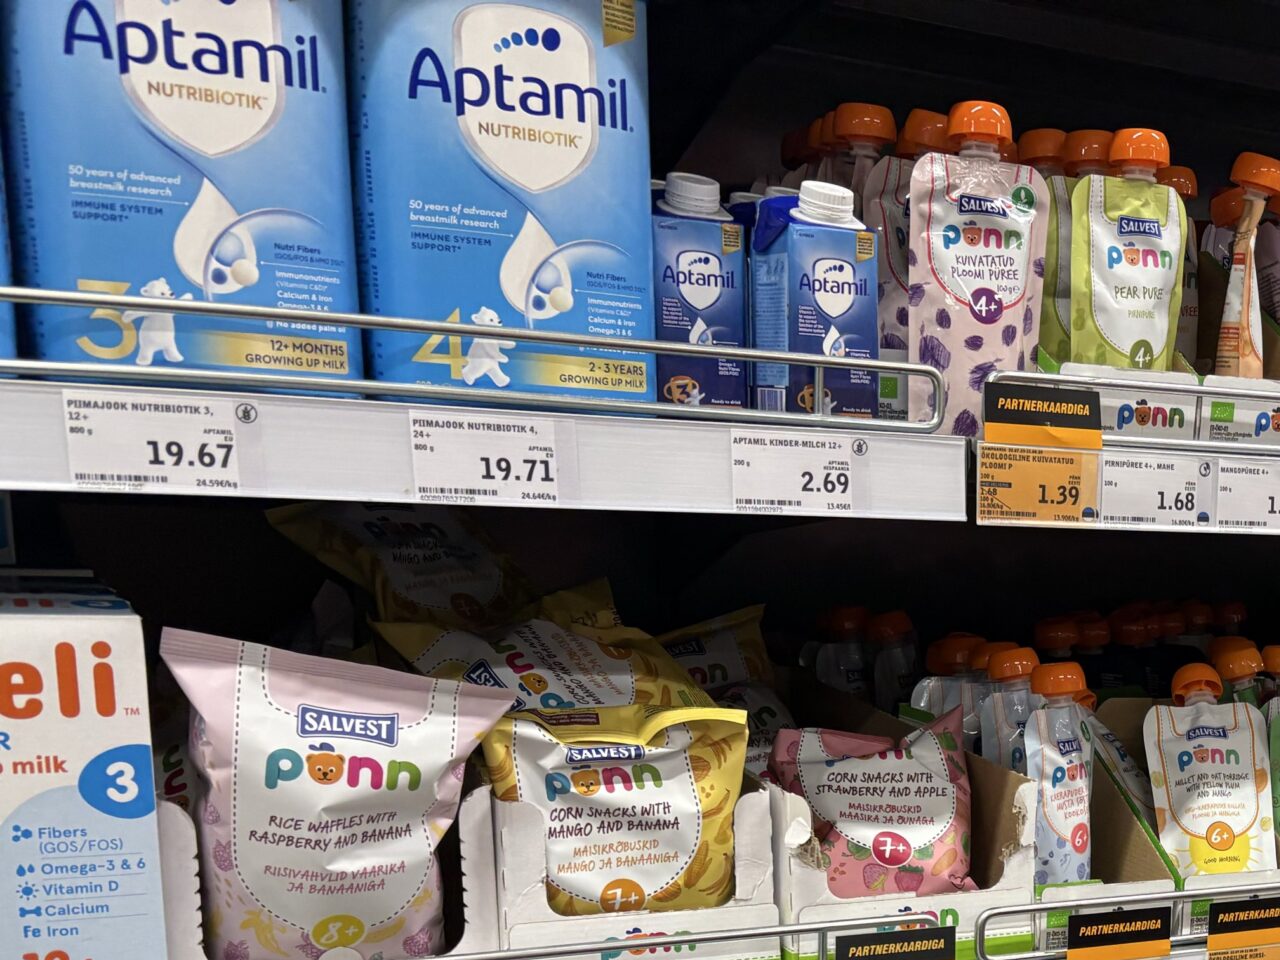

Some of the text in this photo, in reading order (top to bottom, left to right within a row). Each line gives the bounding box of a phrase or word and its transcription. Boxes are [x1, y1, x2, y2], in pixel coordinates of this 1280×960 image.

[63, 0, 321, 93] Aptamil
[147, 80, 262, 110] NUTRIBIOTIK
[408, 47, 630, 133] Aptamil
[478, 121, 578, 148] NUTRIBIOTIK
[409, 200, 507, 220] 50 years of advanced
[955, 254, 1015, 270] KUIVATATUD
[662, 266, 735, 289] Aptamil
[951, 267, 985, 281] PLOOMI
[800, 273, 868, 296] Aptamil
[270, 339, 345, 357] 12+ MONTHS
[245, 352, 346, 370] GROWING UP MILK
[67, 400, 126, 414] PIIMAJOOK
[131, 402, 199, 414] NUTRIBIOTIK
[998, 398, 1090, 416] PARTNERKAARDIGA
[733, 438, 766, 446] APTAMIL
[769, 439, 825, 449] KINDER-MILCH
[146, 439, 233, 468] 19.67
[480, 456, 554, 482] 19.71
[801, 472, 850, 494] 2.69
[1038, 484, 1079, 506] 1.39
[1158, 491, 1194, 511] 1.68
[305, 712, 391, 740] SALVEST
[571, 746, 639, 762] SALVEST
[13, 756, 68, 774] milk
[105, 762, 138, 802] 3
[827, 771, 933, 784] CORN SNACKS WITH
[815, 783, 948, 798] STRAWBERRY AND APPLE
[550, 802, 672, 822] CORN SNACKS WITH
[269, 811, 396, 833] RICE WAFFLES WITH
[548, 816, 680, 839] MANGO AND BANANA
[38, 826, 87, 839] Fibers
[249, 824, 412, 852] RASPBERRY AND BANANA
[40, 838, 123, 855] (GOS/FOS)
[41, 859, 145, 874] Omega-3 & 6
[264, 861, 405, 880] RIISIVAHVLID VAARIKA
[557, 851, 679, 873] MANGO JA BANAANIGA
[42, 881, 119, 895] Vitamin D
[287, 879, 385, 894] JA BANAANIGA
[45, 903, 109, 916] Calcium
[23, 925, 79, 938] Fe Iron
[1079, 919, 1161, 937] PARTNERKAARDIGA
[849, 938, 945, 958] PARTNERKAARDIGA
